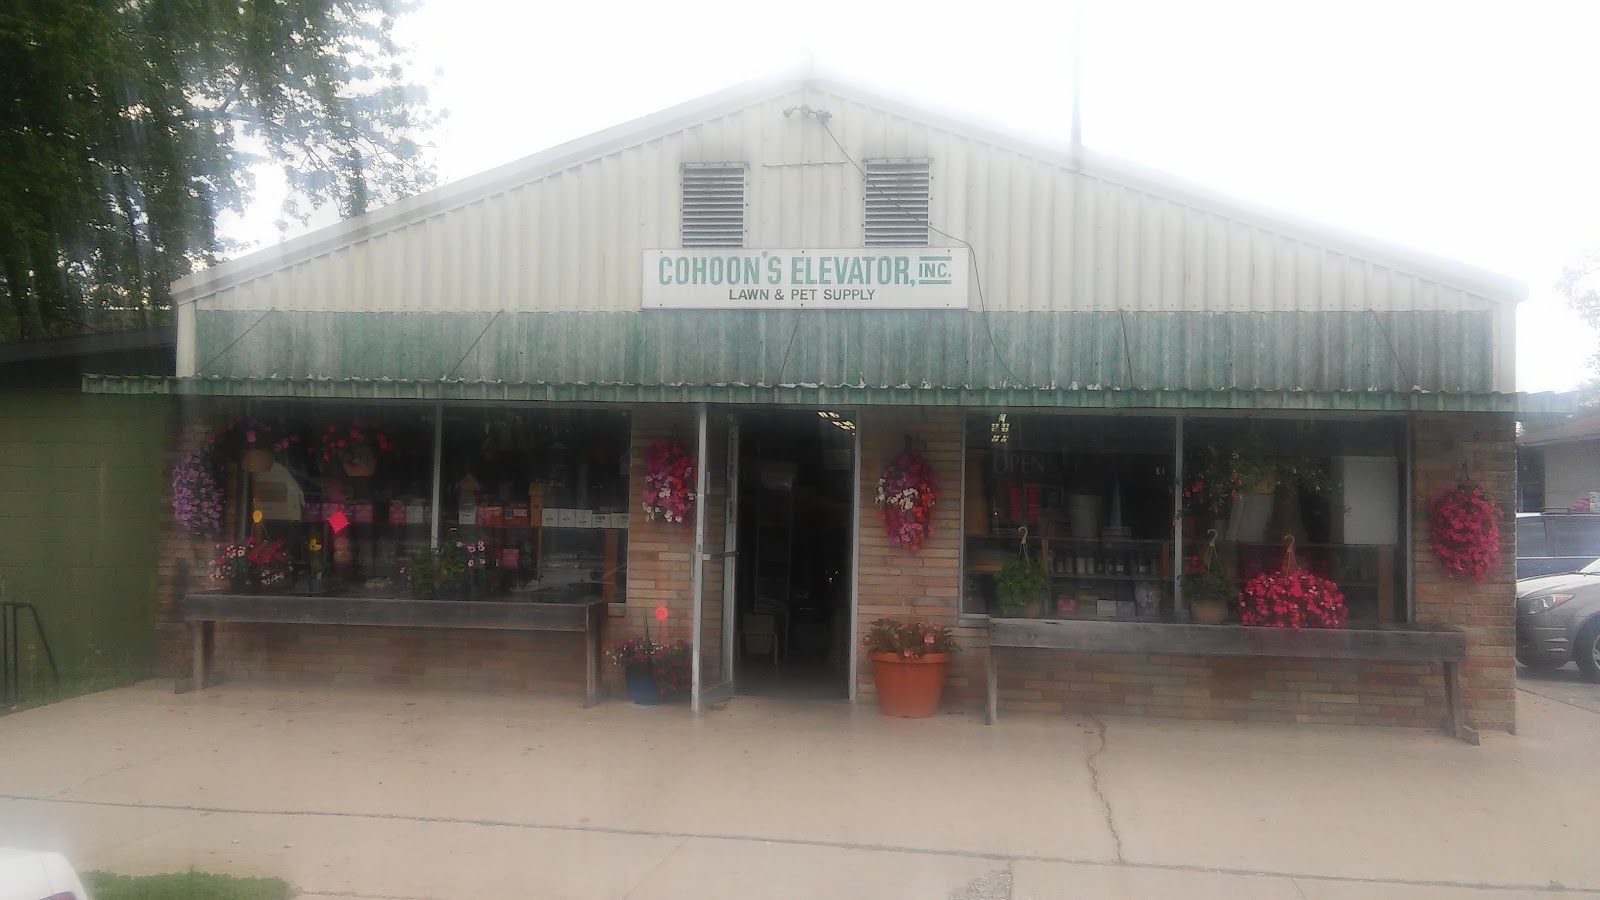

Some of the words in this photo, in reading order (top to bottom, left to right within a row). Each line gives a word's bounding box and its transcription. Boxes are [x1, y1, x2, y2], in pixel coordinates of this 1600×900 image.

[658, 250, 782, 286] COHOON'S
[791, 255, 915, 287] ELEVATOR,
[918, 262, 951, 278] INC.
[729, 288, 770, 301] LAWN
[774, 288, 785, 301] &
[791, 288, 818, 301] PET
[823, 288, 876, 301] SUPPLY
[992, 452, 1046, 474] OPEN
